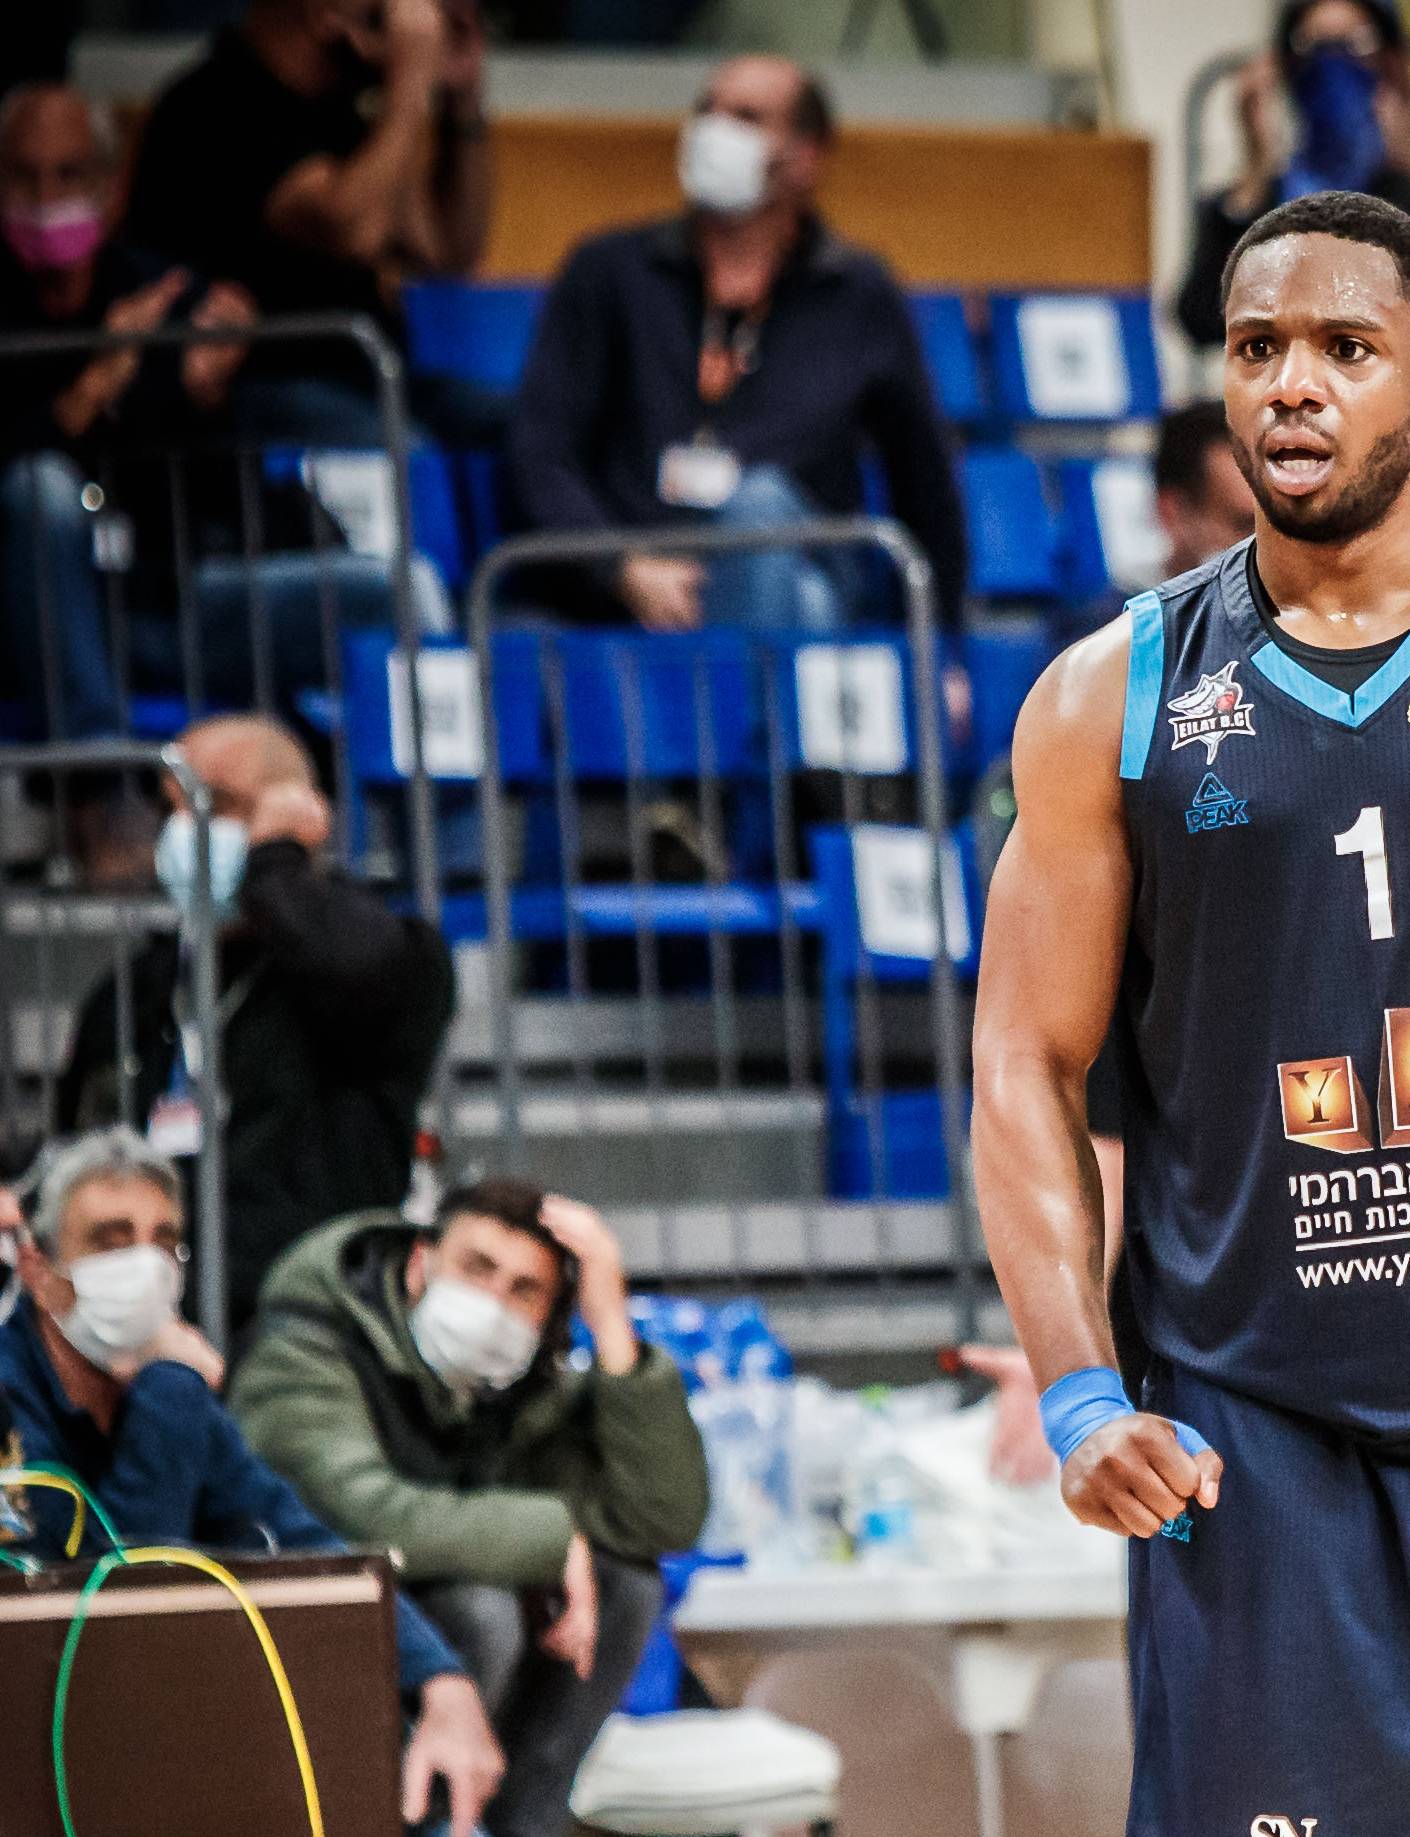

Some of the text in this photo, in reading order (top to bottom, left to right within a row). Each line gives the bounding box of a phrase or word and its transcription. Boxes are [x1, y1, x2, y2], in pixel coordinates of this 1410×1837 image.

[1178, 716, 1218, 738] EILAT
[1185, 799, 1249, 833] PEAK
[1333, 805, 1395, 941] 1
[1288, 1067, 1344, 1125] Y
[1294, 1210, 1353, 1239] חיים
